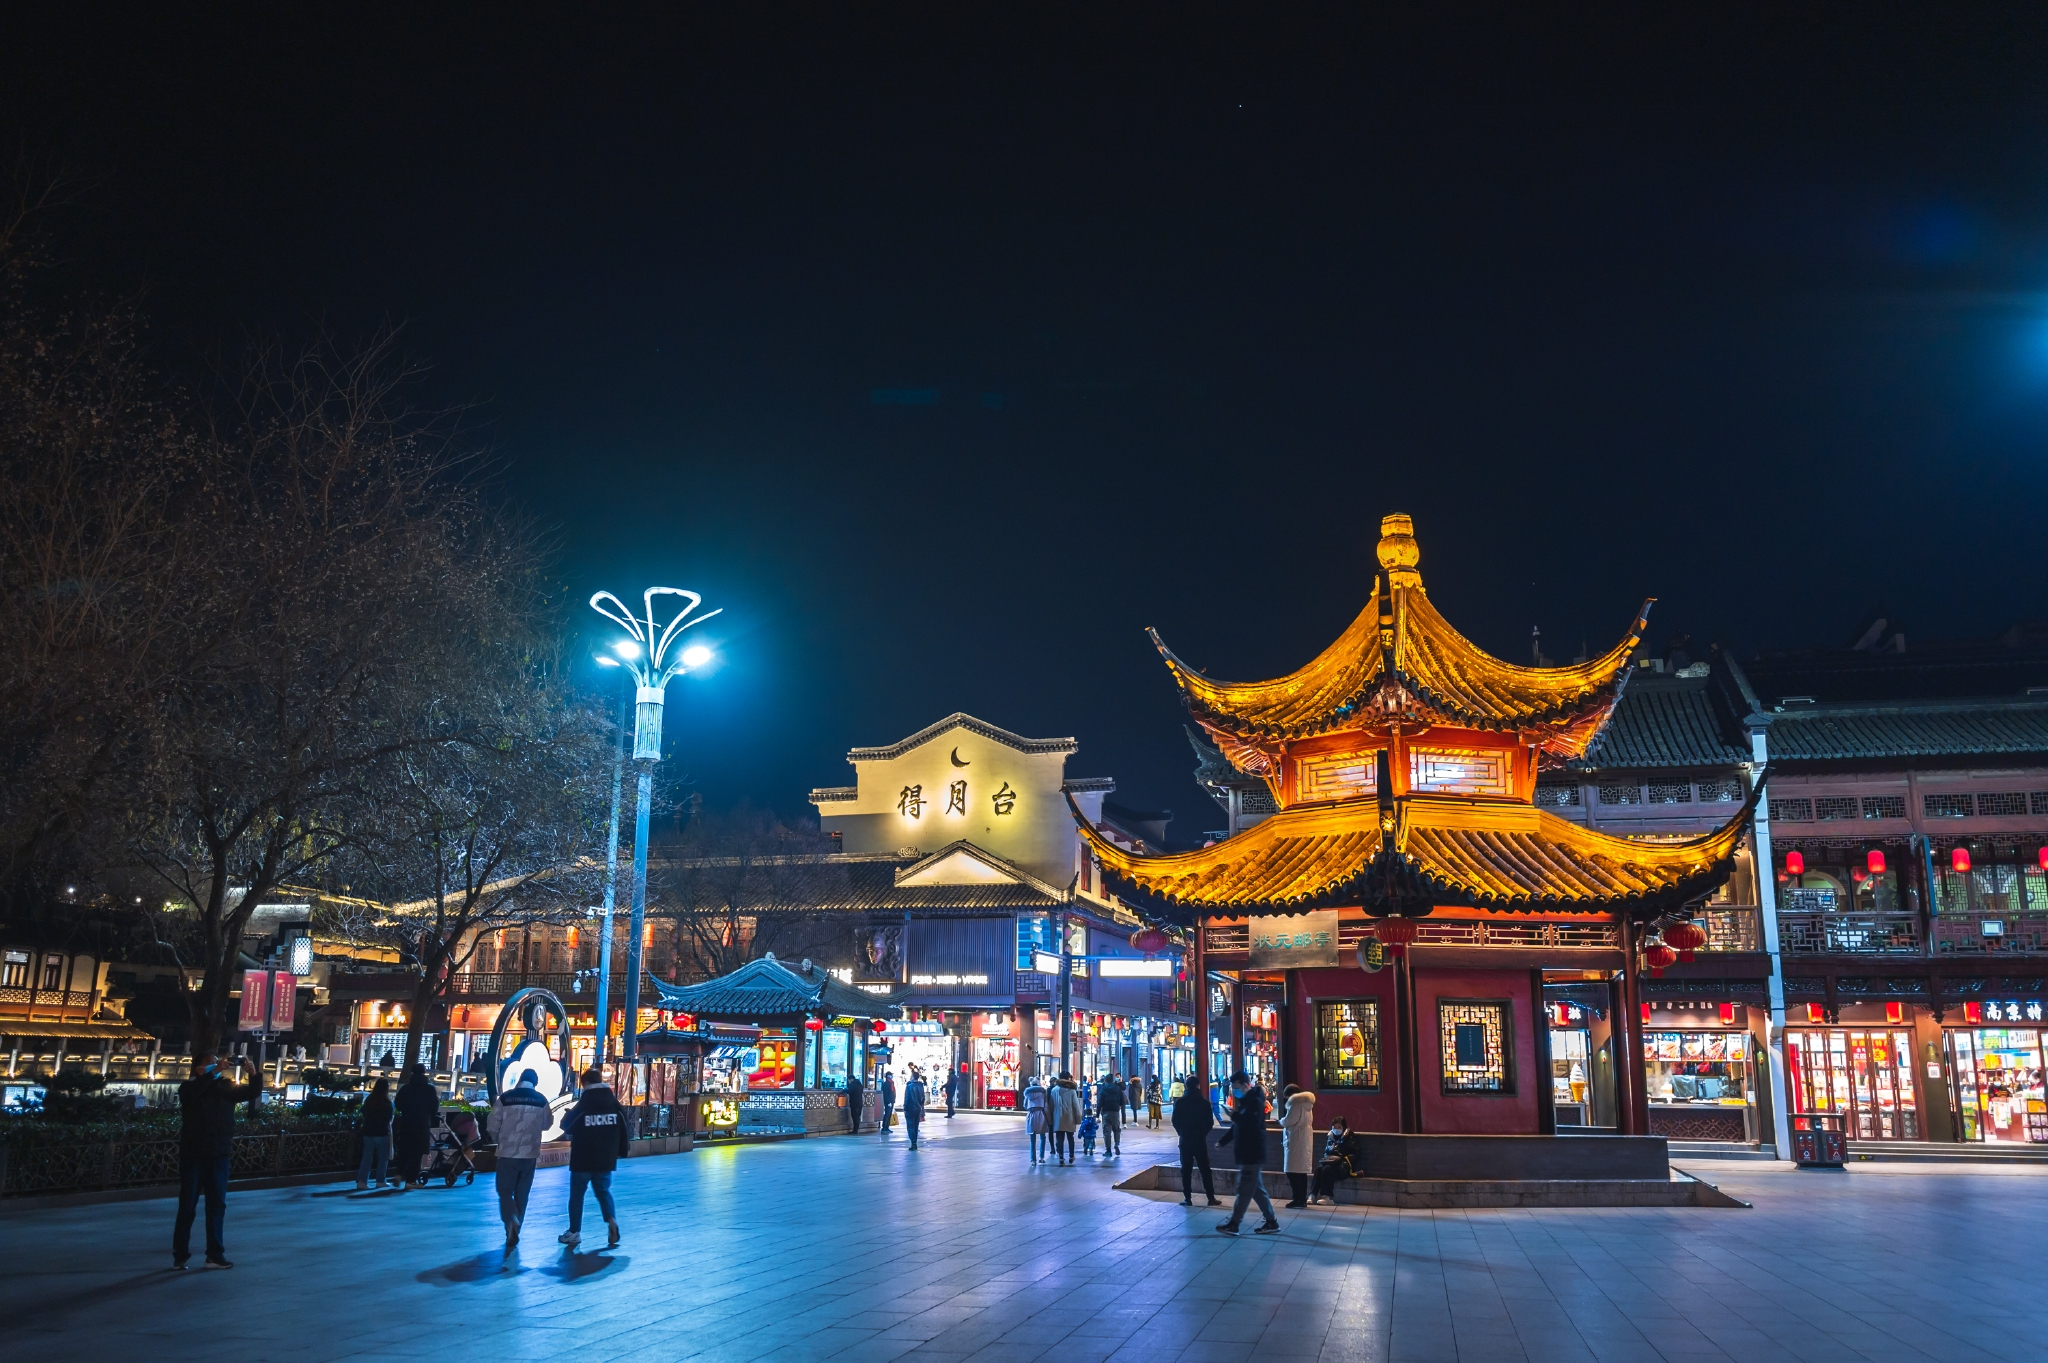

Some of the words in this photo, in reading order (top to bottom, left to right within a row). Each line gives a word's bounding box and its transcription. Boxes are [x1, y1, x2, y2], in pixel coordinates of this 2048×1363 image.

[897, 779, 1017, 820] 得月台
[1253, 931, 1332, 950] 状元邮亭
[1986, 1003, 2042, 1022] 南京特
[584, 1113, 618, 1127] BUCKET
